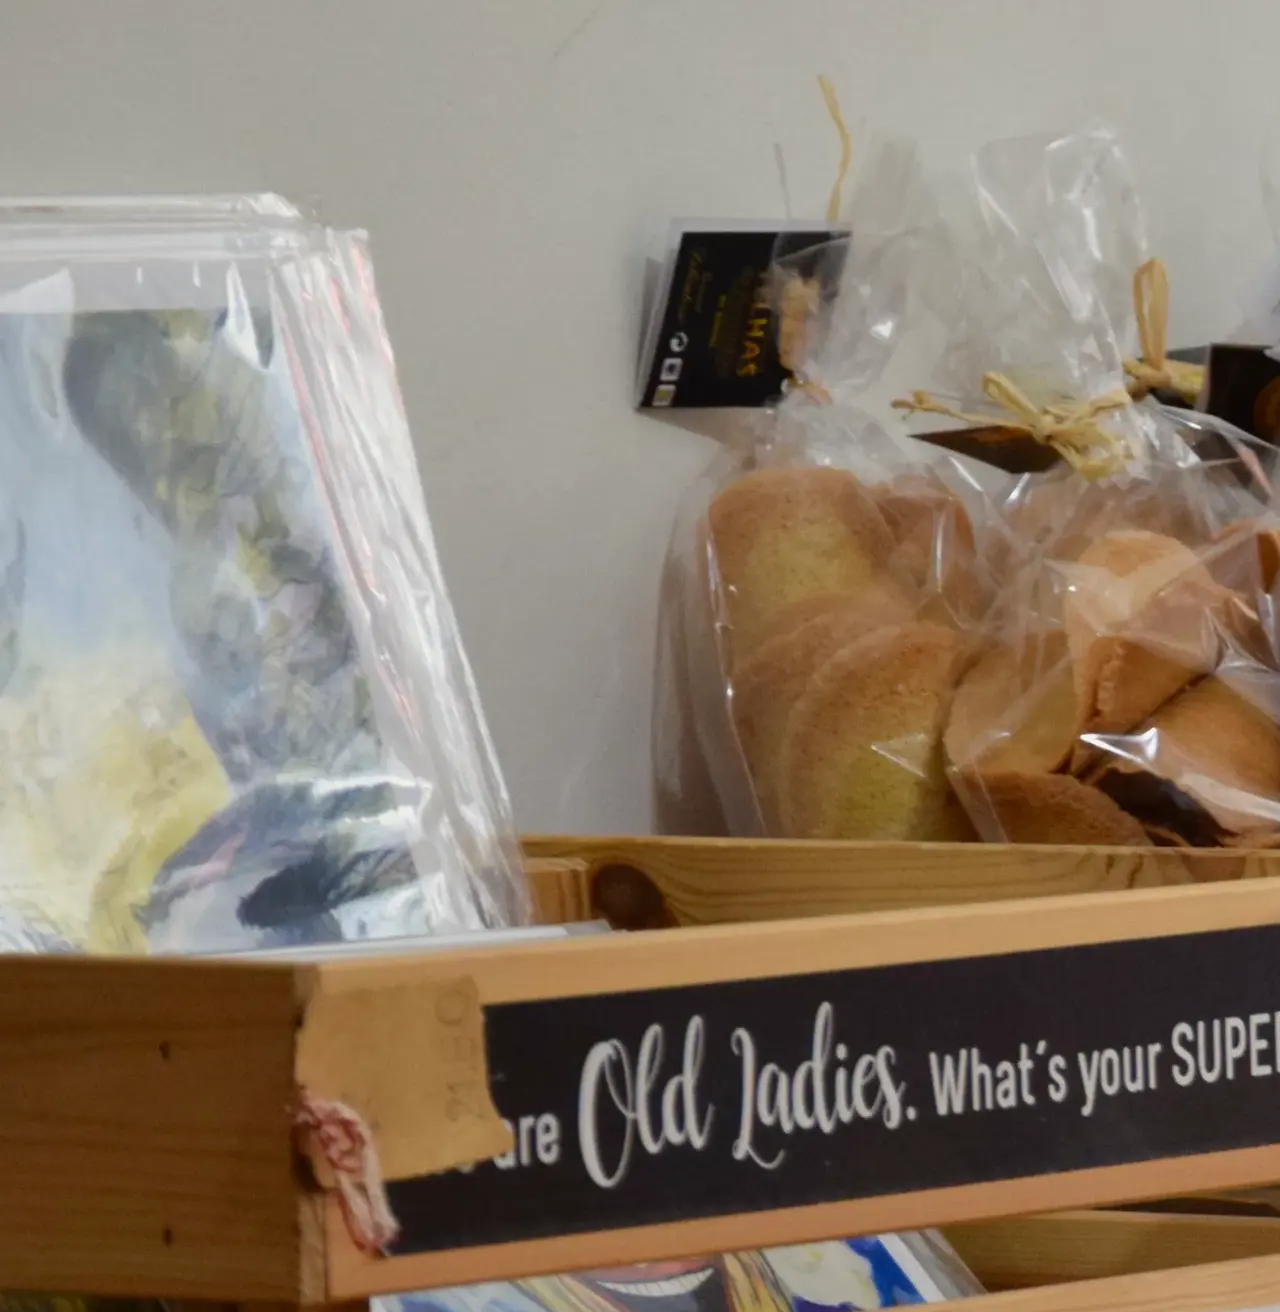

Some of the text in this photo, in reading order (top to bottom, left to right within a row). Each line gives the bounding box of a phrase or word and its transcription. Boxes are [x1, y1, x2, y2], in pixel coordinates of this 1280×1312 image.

[577, 1014, 716, 1188] Old
[731, 1001, 917, 1169] Ladies.
[929, 1040, 1068, 1117] What's
[1079, 1042, 1162, 1117] your
